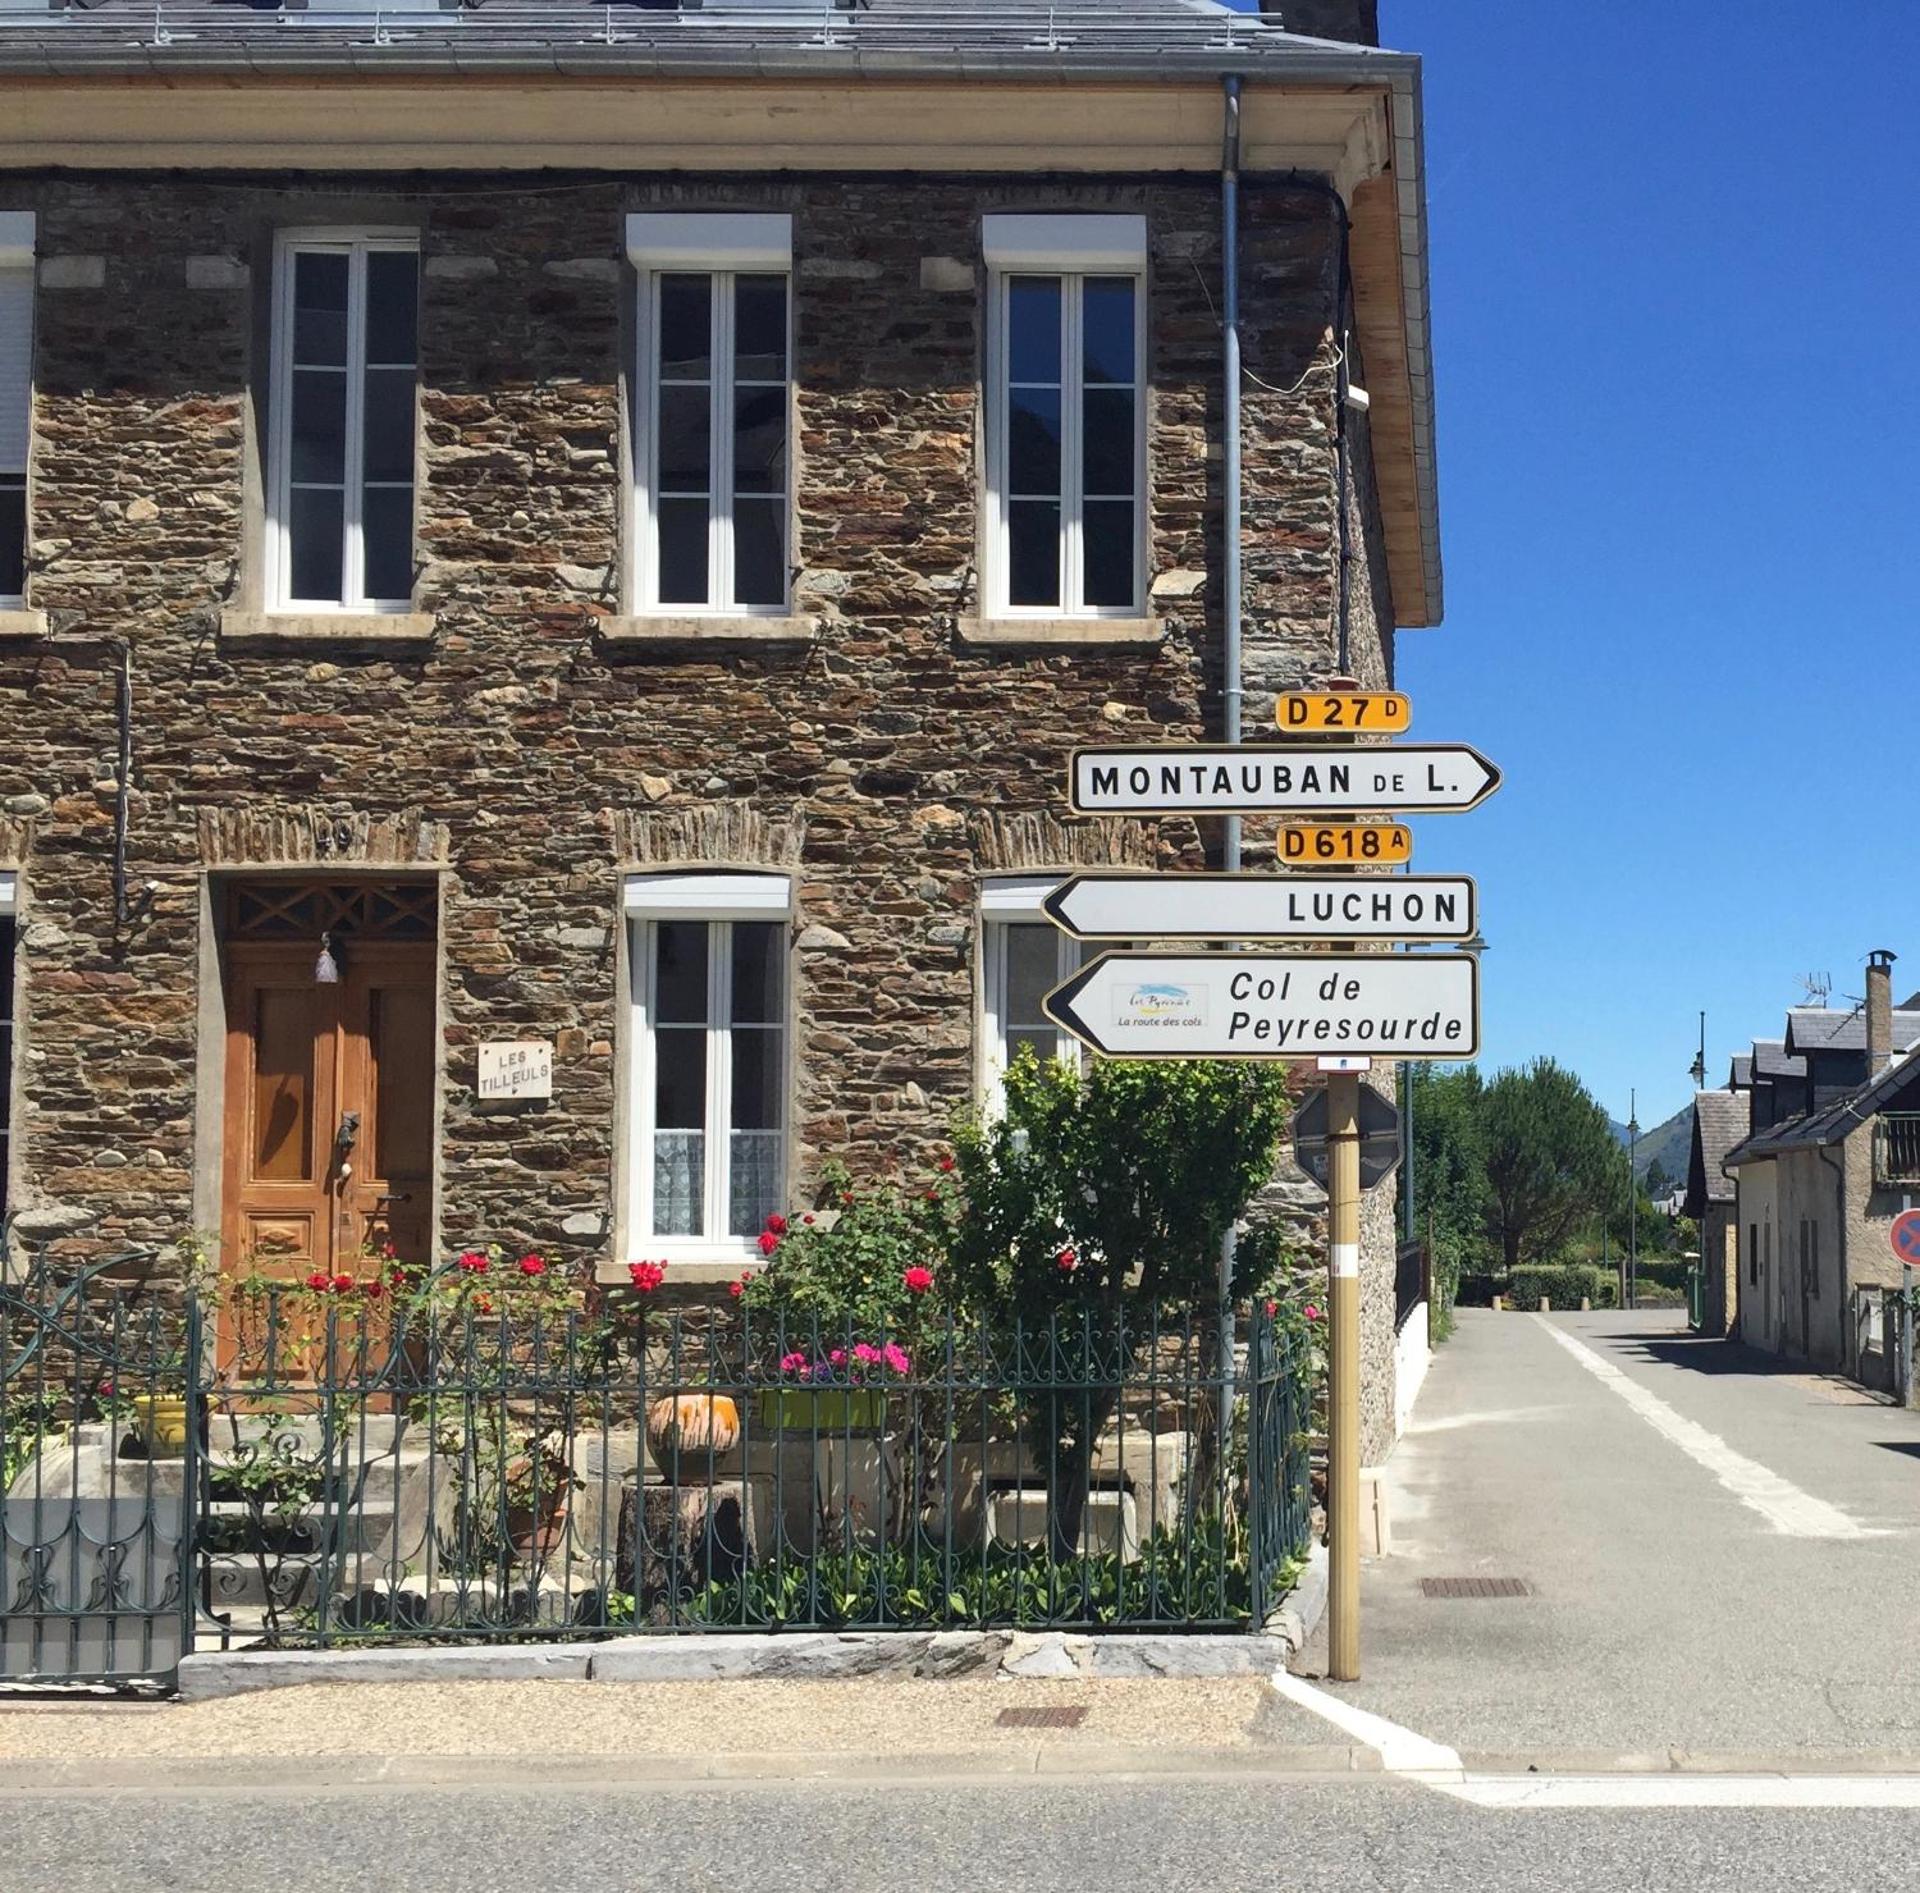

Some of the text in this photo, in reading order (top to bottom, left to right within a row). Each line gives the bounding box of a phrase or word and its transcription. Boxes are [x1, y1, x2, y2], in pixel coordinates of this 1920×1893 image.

[1092, 764, 1458, 795] MONTAUBAN DE L.
[1289, 893, 1455, 922] LUCHON
[1230, 972, 1361, 1001] Col de
[1118, 1016, 1202, 1026] La route des cols
[1228, 1012, 1462, 1046] Peyresourde
[481, 1050, 549, 1093] LES TILLEULS
